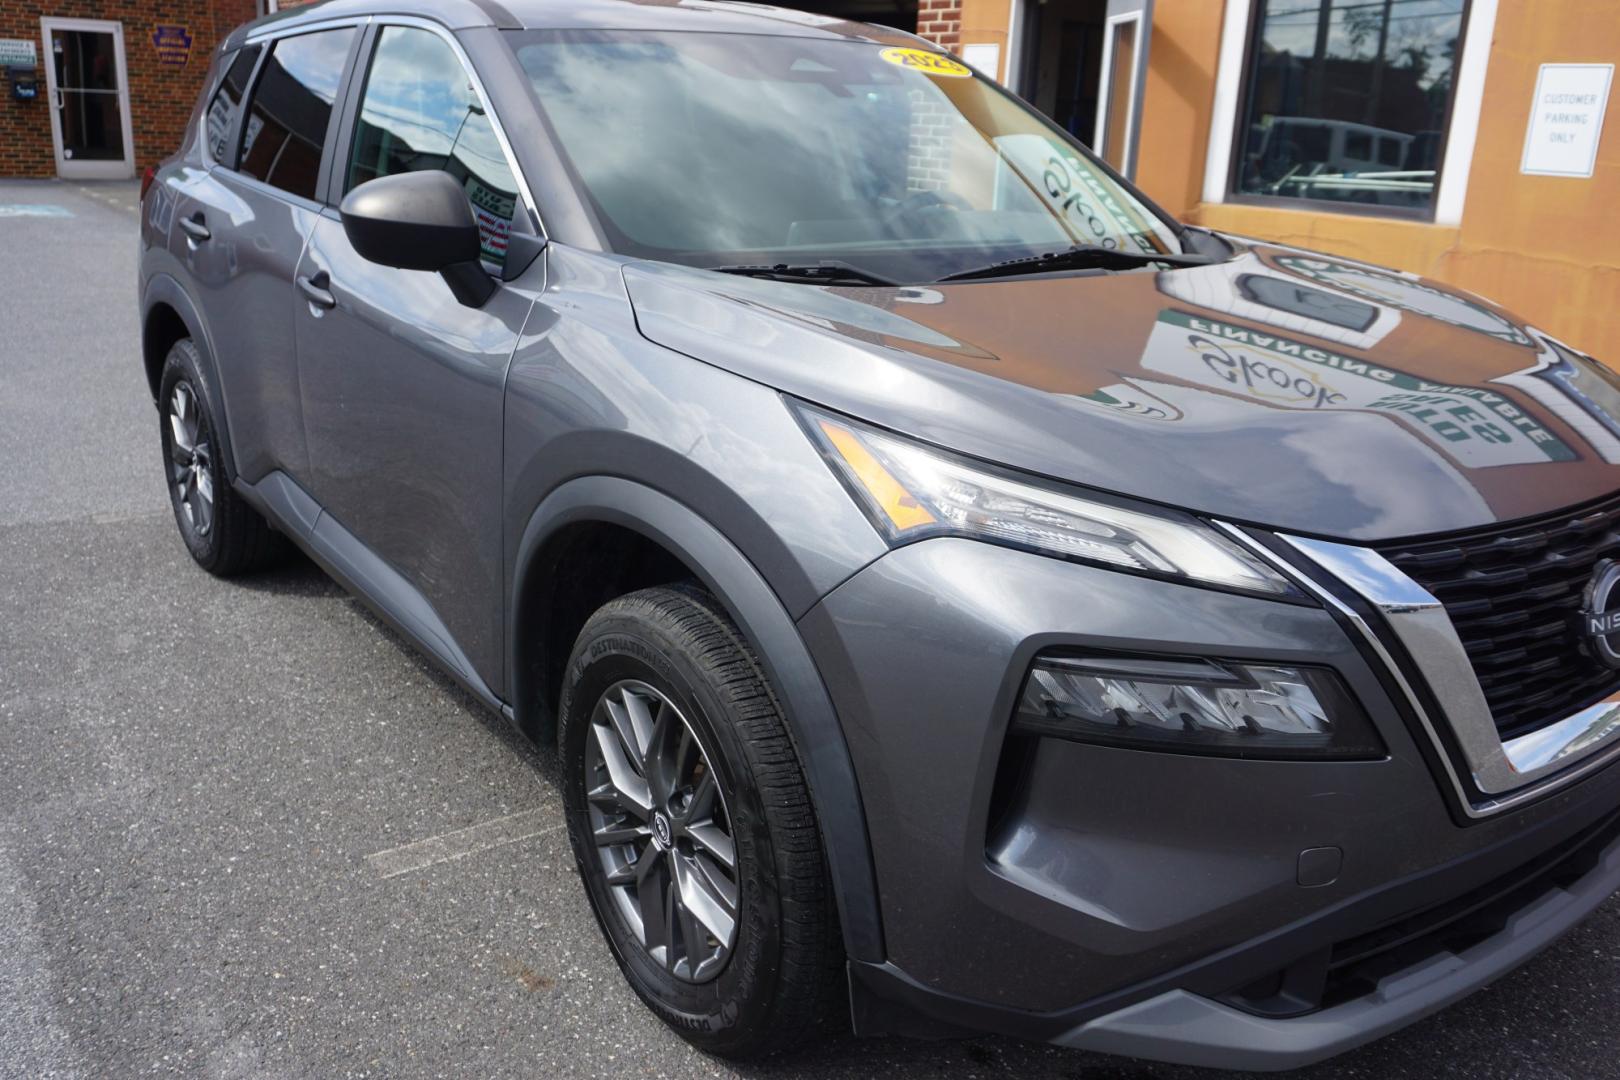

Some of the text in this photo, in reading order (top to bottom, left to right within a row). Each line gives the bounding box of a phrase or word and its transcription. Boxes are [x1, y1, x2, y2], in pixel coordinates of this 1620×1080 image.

[1544, 93, 1597, 105] CUSTOMER
[1544, 112, 1589, 124] PARKING
[1549, 132, 1576, 143] ONLY
